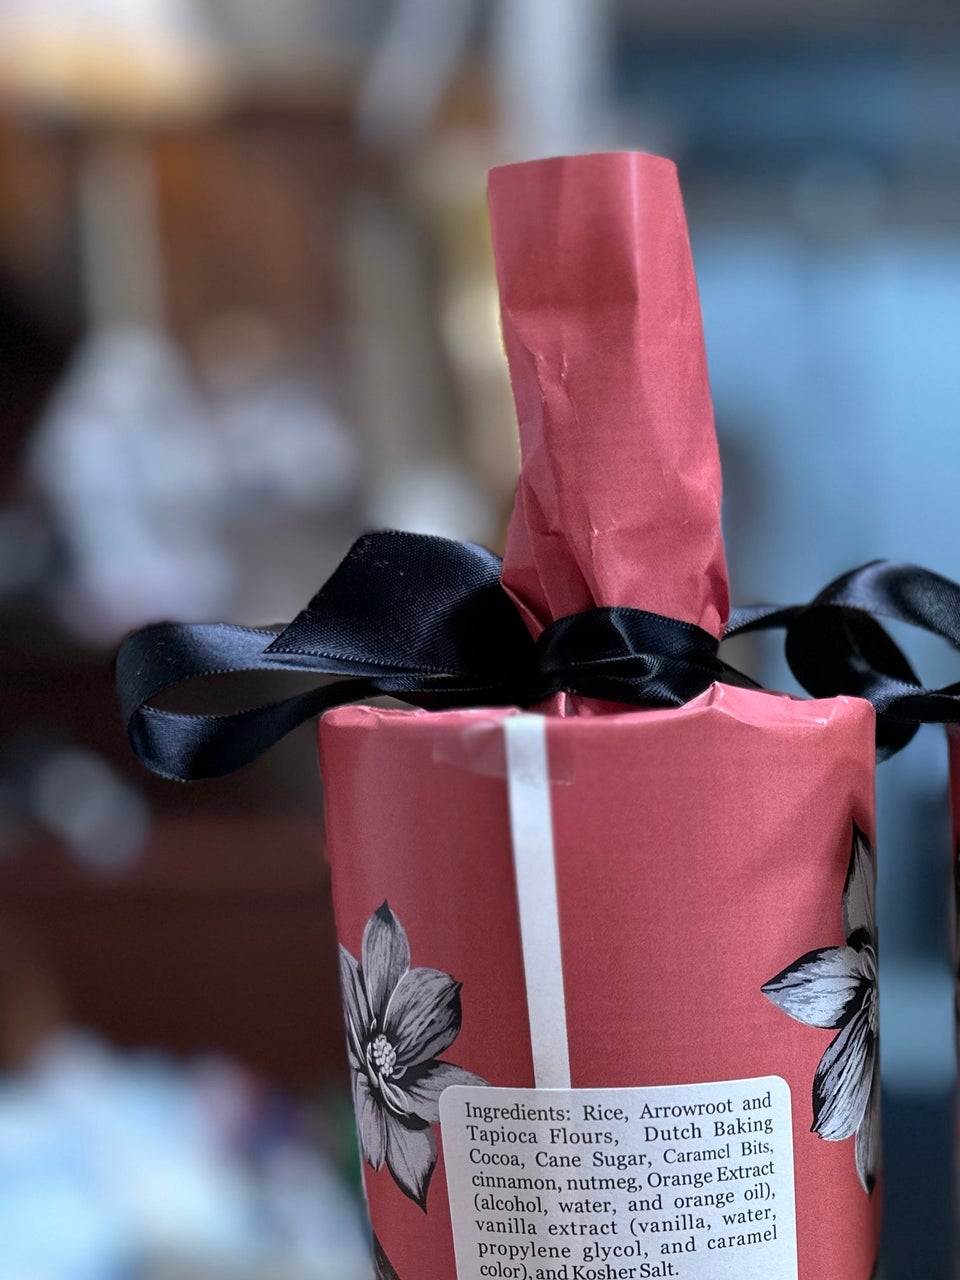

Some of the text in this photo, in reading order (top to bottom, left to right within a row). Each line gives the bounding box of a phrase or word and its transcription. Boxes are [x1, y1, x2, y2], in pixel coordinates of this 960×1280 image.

[465, 1091, 772, 1125] Ingredients: Rice, Arrowroot and
[466, 1116, 774, 1147] Tapioca Flours, Dutch Baking
[469, 1140, 774, 1171] Cocoa, Cane Sugar, Caramel Bits,
[472, 1160, 775, 1193] cinnamon, nutmeg, Orange Extract
[474, 1182, 776, 1216] (alcohol, water, and orange oil),
[477, 1207, 776, 1237] vanilla extract (vanilla, water,
[478, 1225, 777, 1262] propylene glycol, and caramel
[535, 1264, 568, 1280] and
[640, 1260, 679, 1279] Salt.
